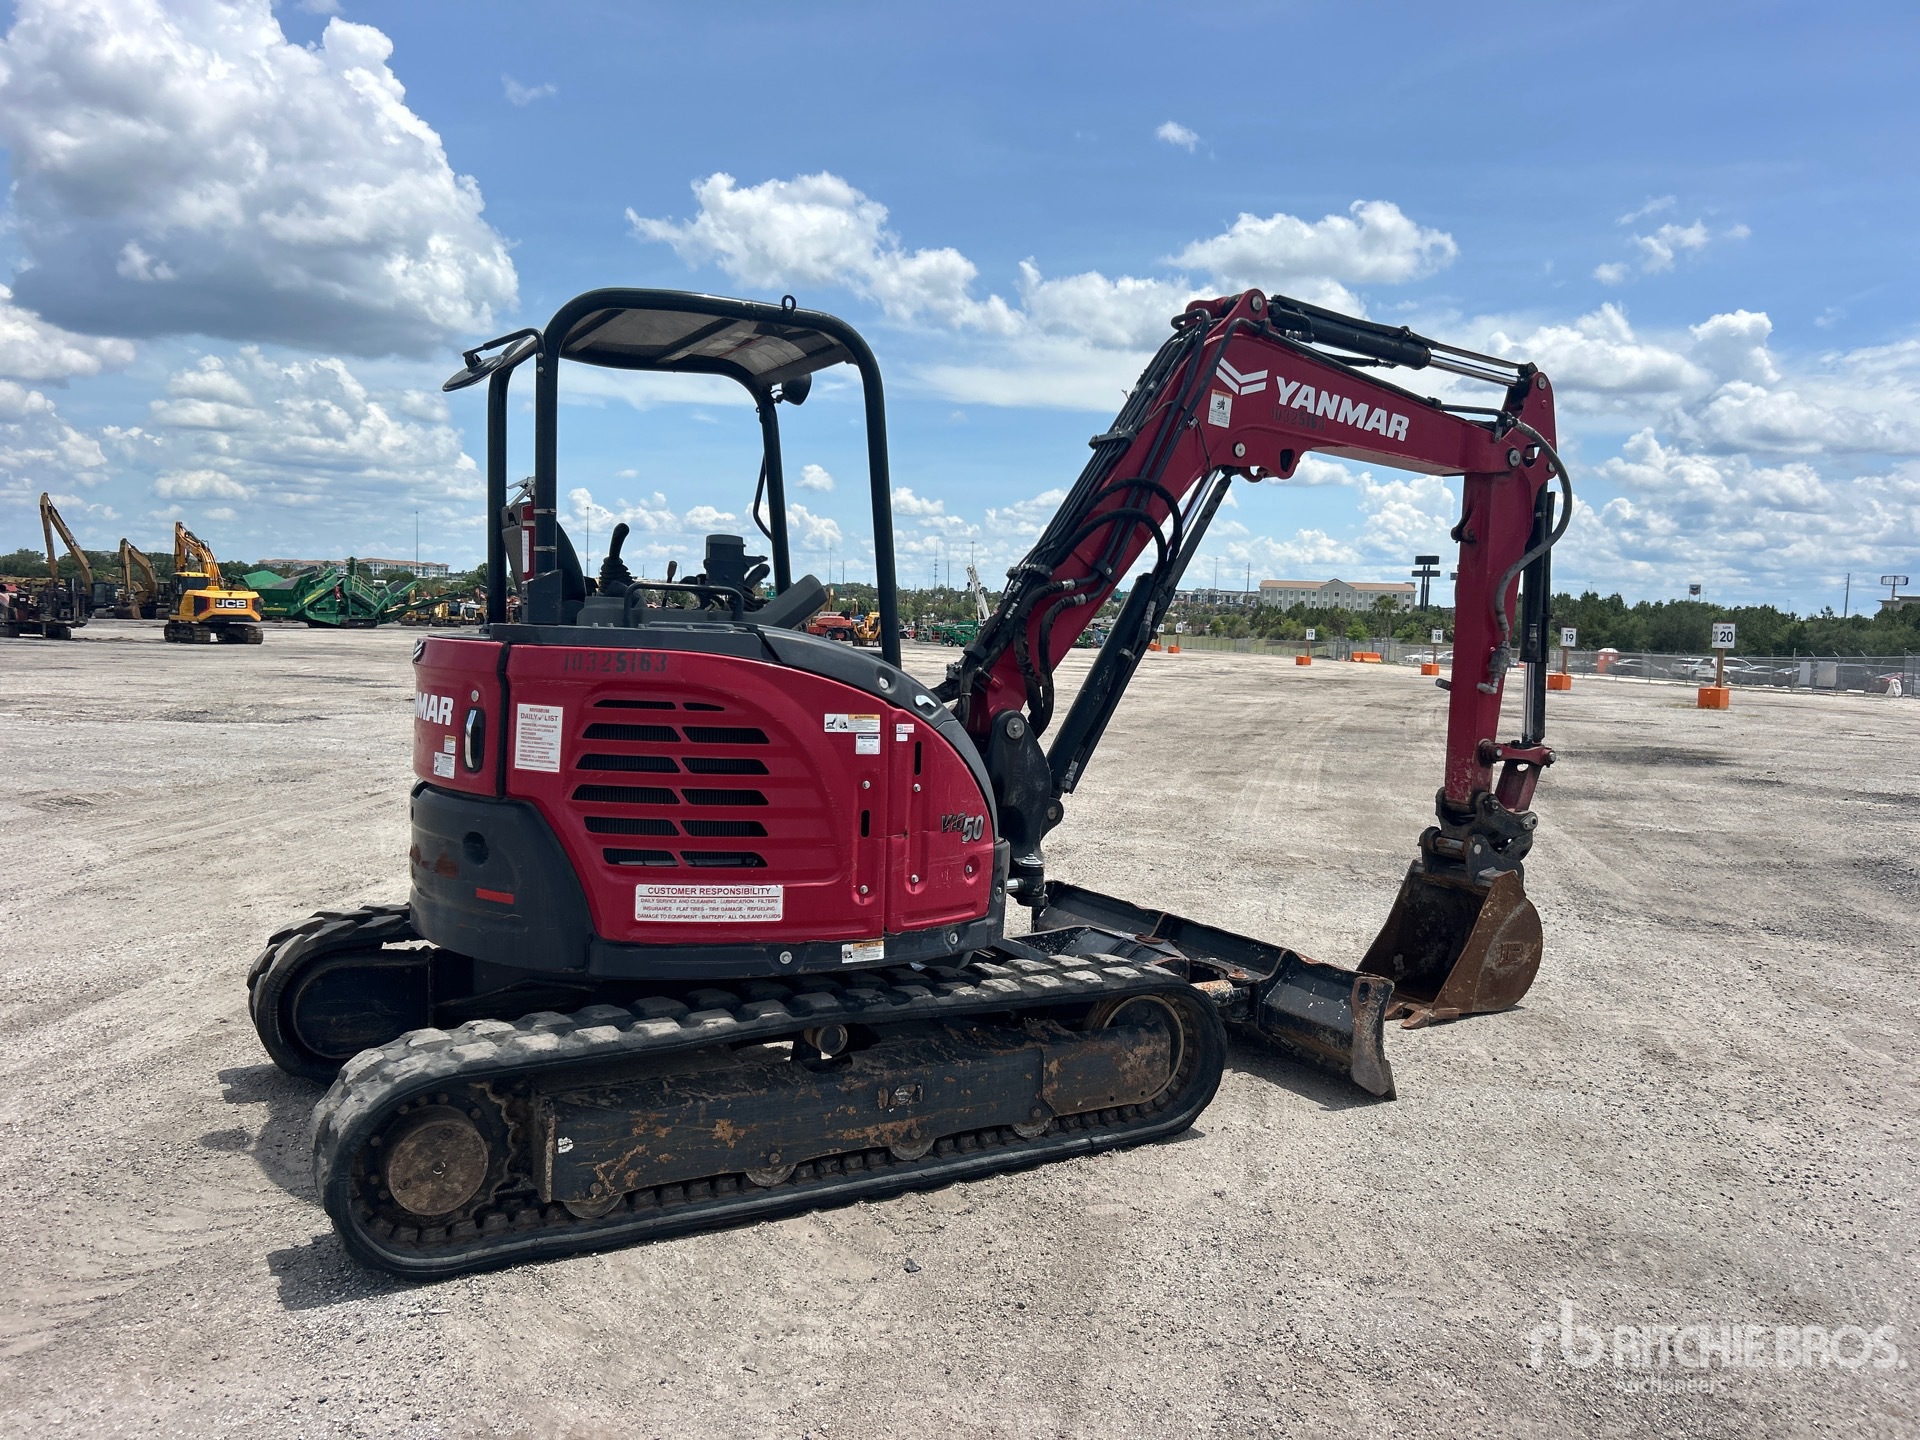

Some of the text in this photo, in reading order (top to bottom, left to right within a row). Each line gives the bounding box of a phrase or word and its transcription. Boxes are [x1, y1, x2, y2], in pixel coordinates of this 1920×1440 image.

[1276, 376, 1410, 442] YANMAR
[216, 599, 247, 608] JCB
[1565, 633, 1574, 642] 19
[1720, 631, 1733, 642] 20
[564, 651, 668, 673] 10325163
[415, 691, 454, 726] MAR
[647, 887, 771, 896] CUSTOMER RESPONSIBILITY
